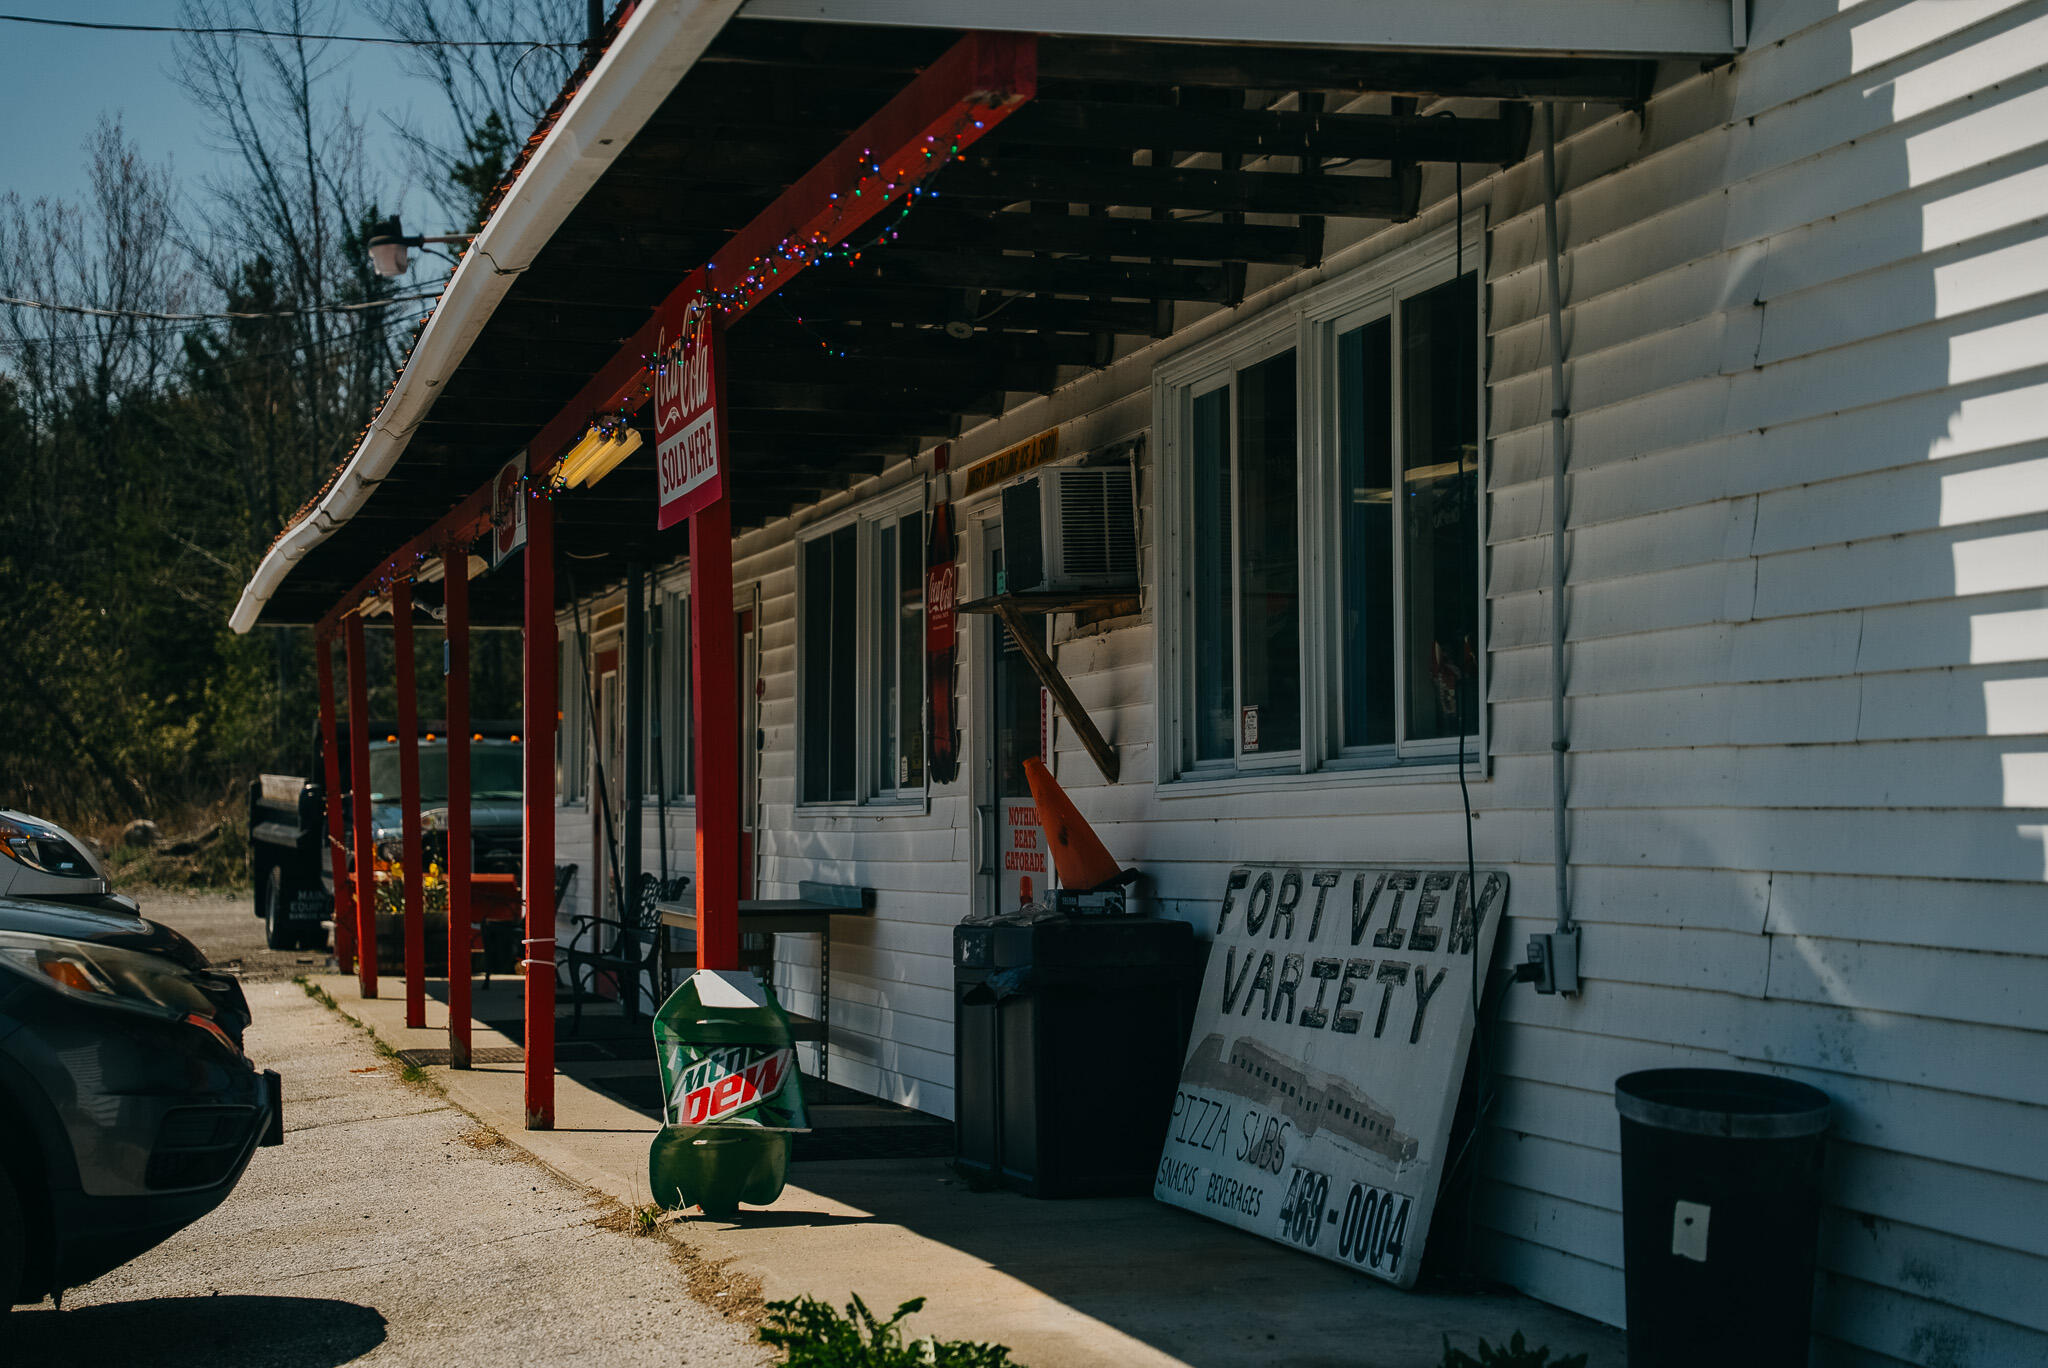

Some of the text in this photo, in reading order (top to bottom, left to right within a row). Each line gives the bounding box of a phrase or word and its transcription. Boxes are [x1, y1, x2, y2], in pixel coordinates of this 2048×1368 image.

[661, 420, 714, 495] SOLD HERE
[1014, 829, 1036, 849] BEATS
[1216, 869, 1502, 955] FORT VIEW
[1222, 945, 1449, 1044] VARIETY
[1172, 1091, 1291, 1175] PIZZA SUBS
[1158, 1156, 1264, 1217] SNACKS BEVERAGES
